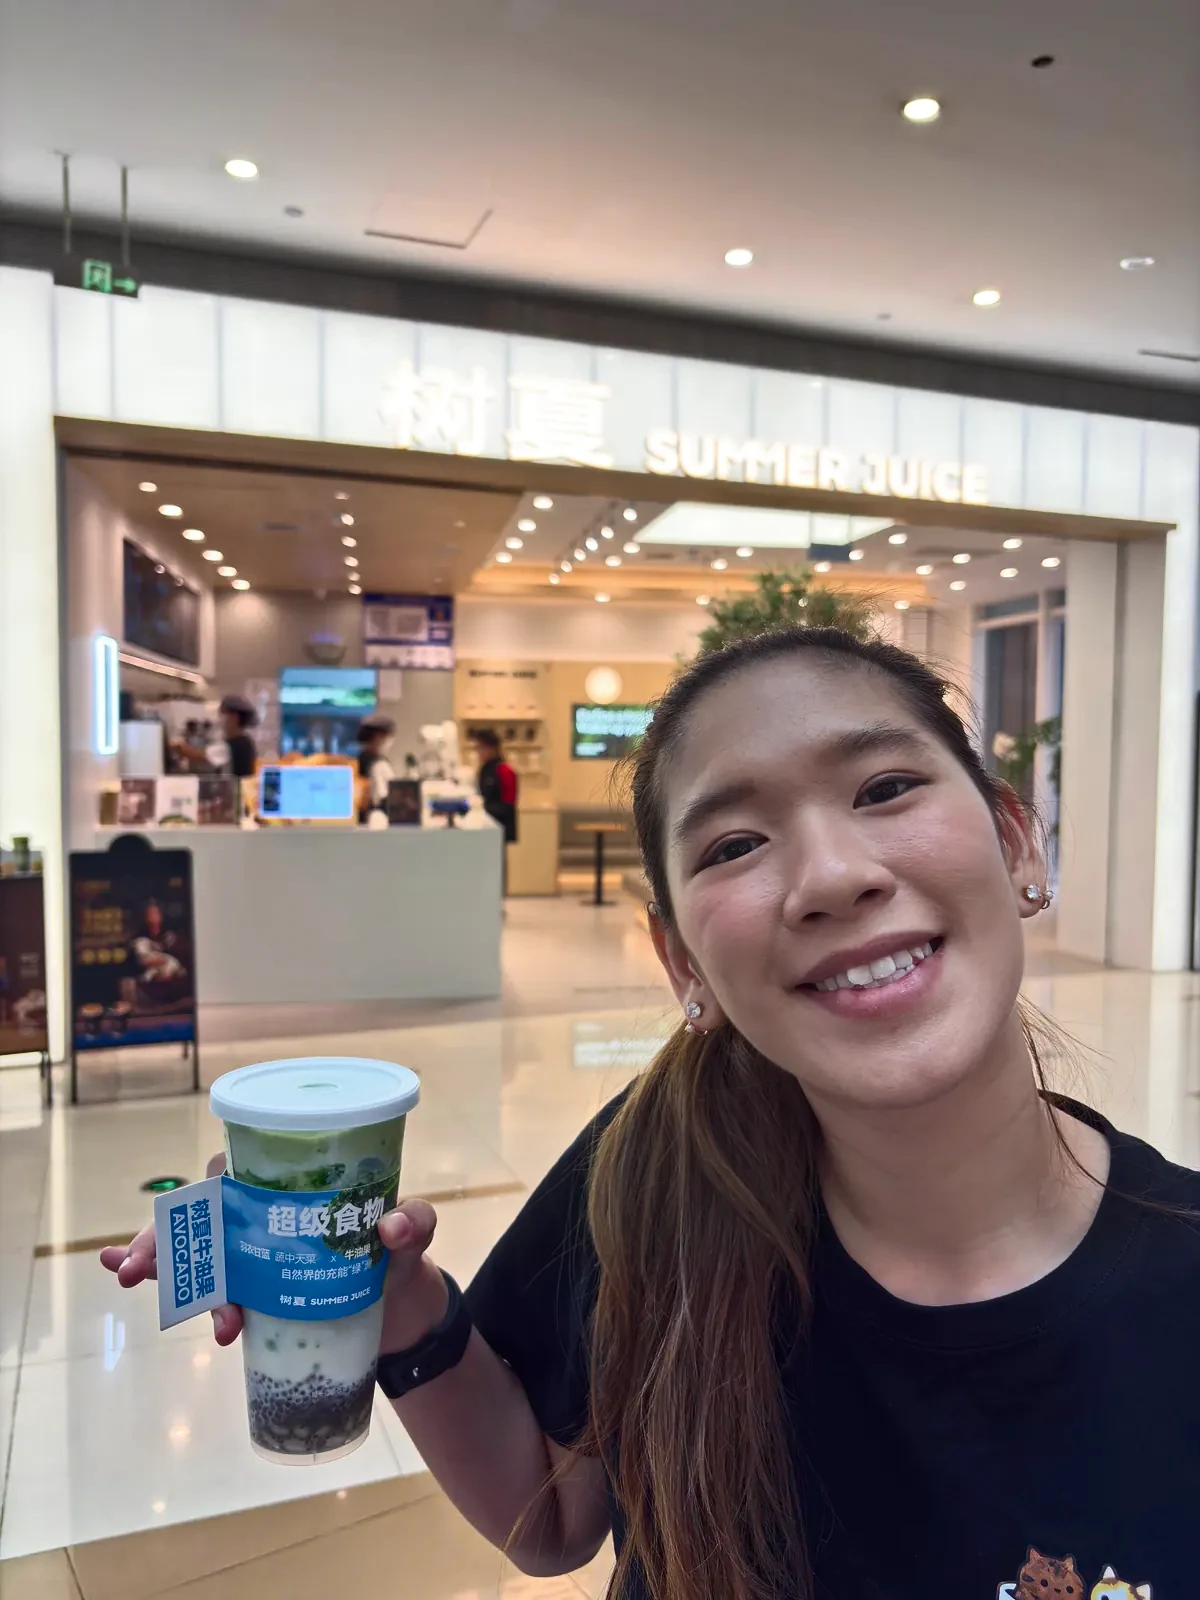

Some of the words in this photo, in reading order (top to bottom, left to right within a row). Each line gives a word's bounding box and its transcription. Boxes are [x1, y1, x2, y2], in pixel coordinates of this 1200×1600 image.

[380, 362, 613, 470] 树夏
[645, 429, 851, 492] SUMMER
[861, 454, 990, 506] JUICE
[190, 1198, 215, 1300] 树夏牛油果
[267, 1196, 385, 1238] 超级食物
[172, 1213, 190, 1301] AVOCADO
[344, 1243, 372, 1261] 牛油果
[279, 1294, 307, 1307] 树夏
[310, 1295, 349, 1306] SUMMER
[350, 1286, 371, 1301] JUICE
